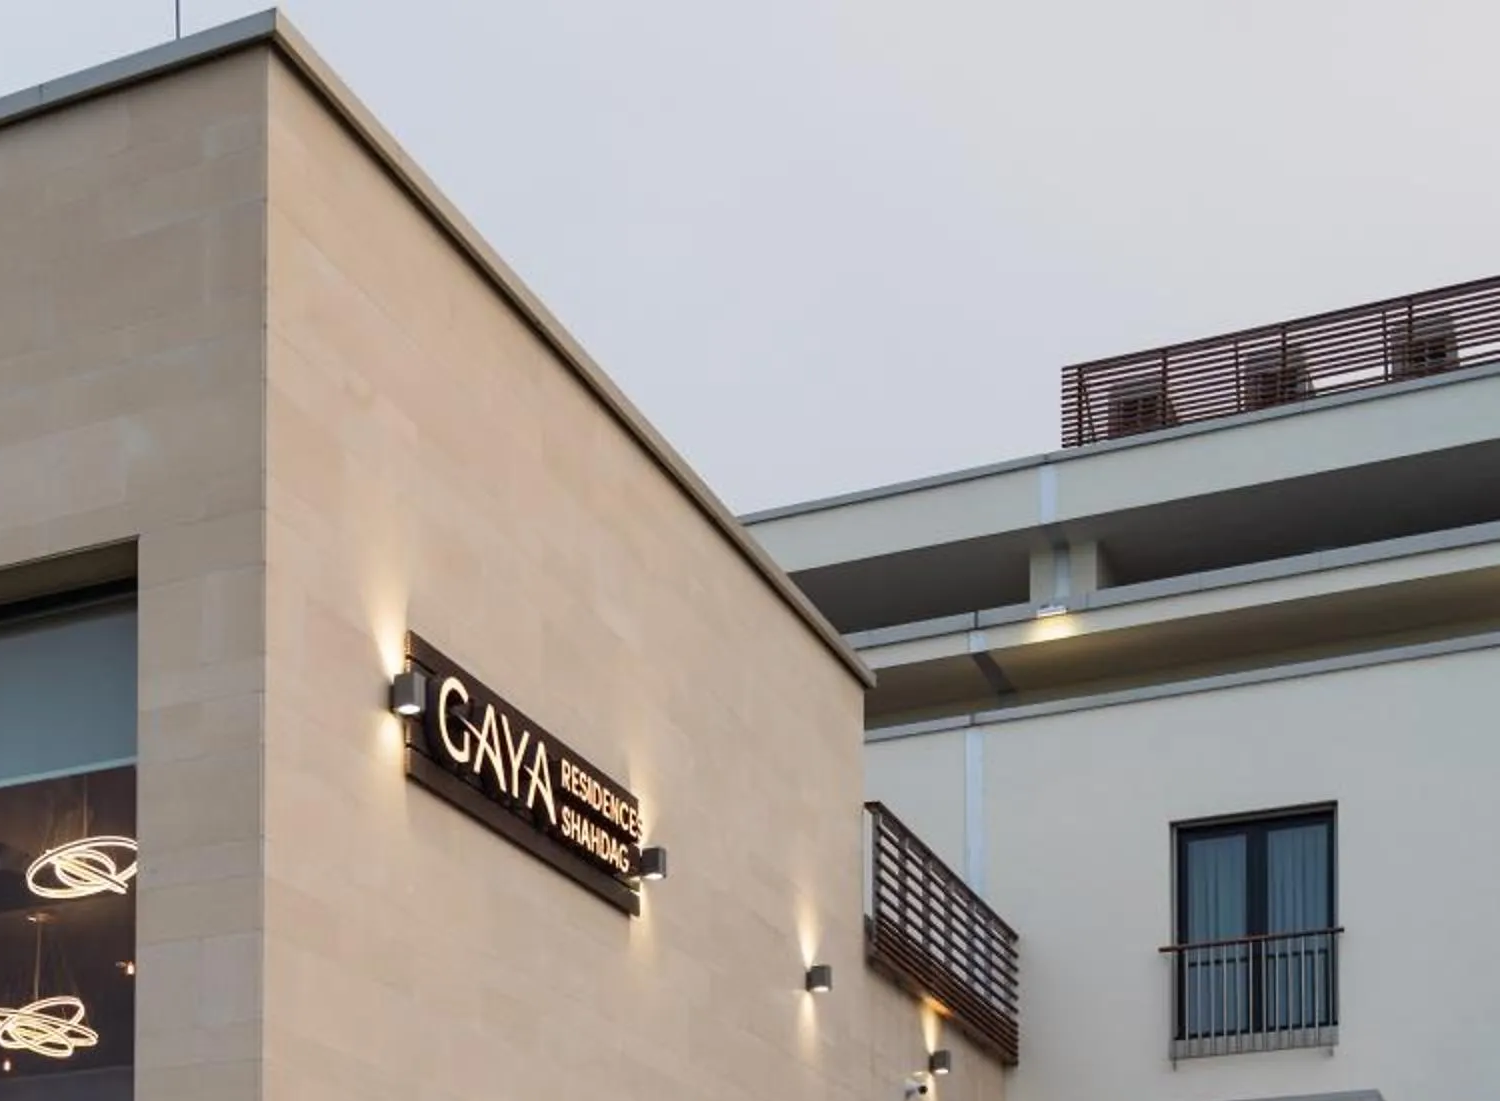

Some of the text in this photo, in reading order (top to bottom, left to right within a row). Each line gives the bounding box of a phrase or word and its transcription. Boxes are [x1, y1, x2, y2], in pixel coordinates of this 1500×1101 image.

[439, 677, 557, 825] GAYA
[561, 758, 643, 838] RESIDENCES
[561, 806, 629, 873] SHAHDAG
